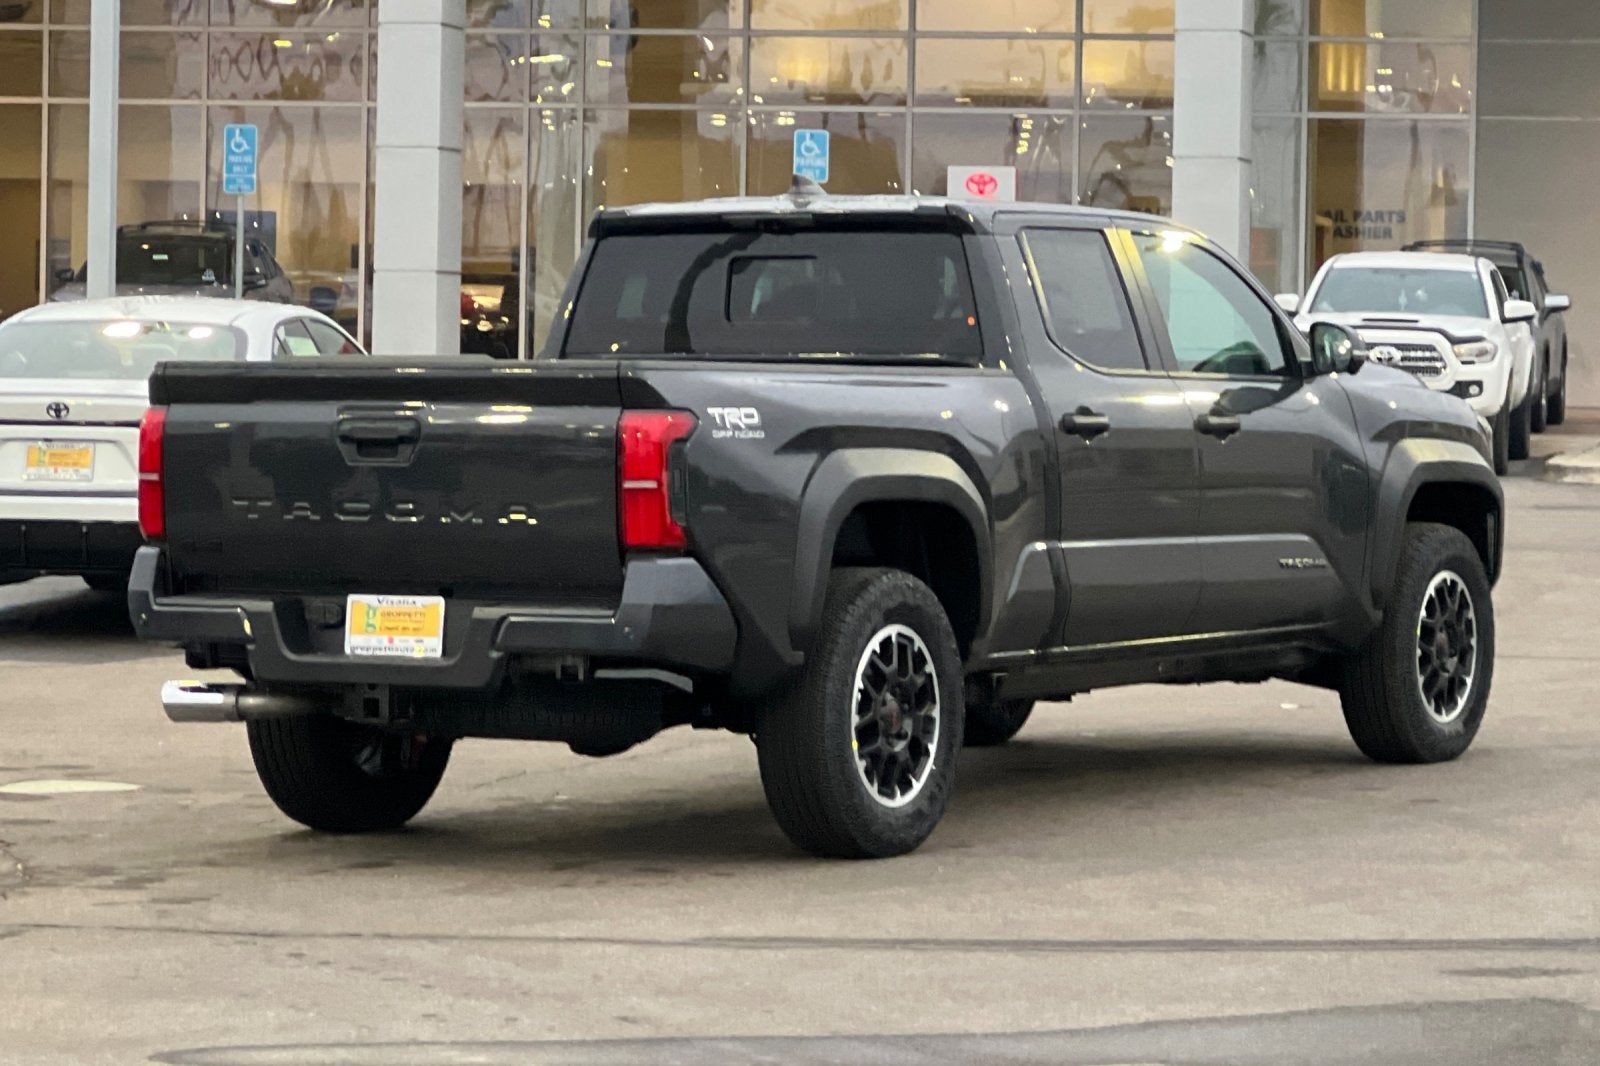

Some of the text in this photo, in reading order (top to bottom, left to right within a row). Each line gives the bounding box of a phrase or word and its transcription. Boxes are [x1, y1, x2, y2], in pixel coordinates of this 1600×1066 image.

[1353, 209, 1406, 223] PARTS
[707, 407, 760, 429] TRD
[232, 501, 538, 526] TACOMA
